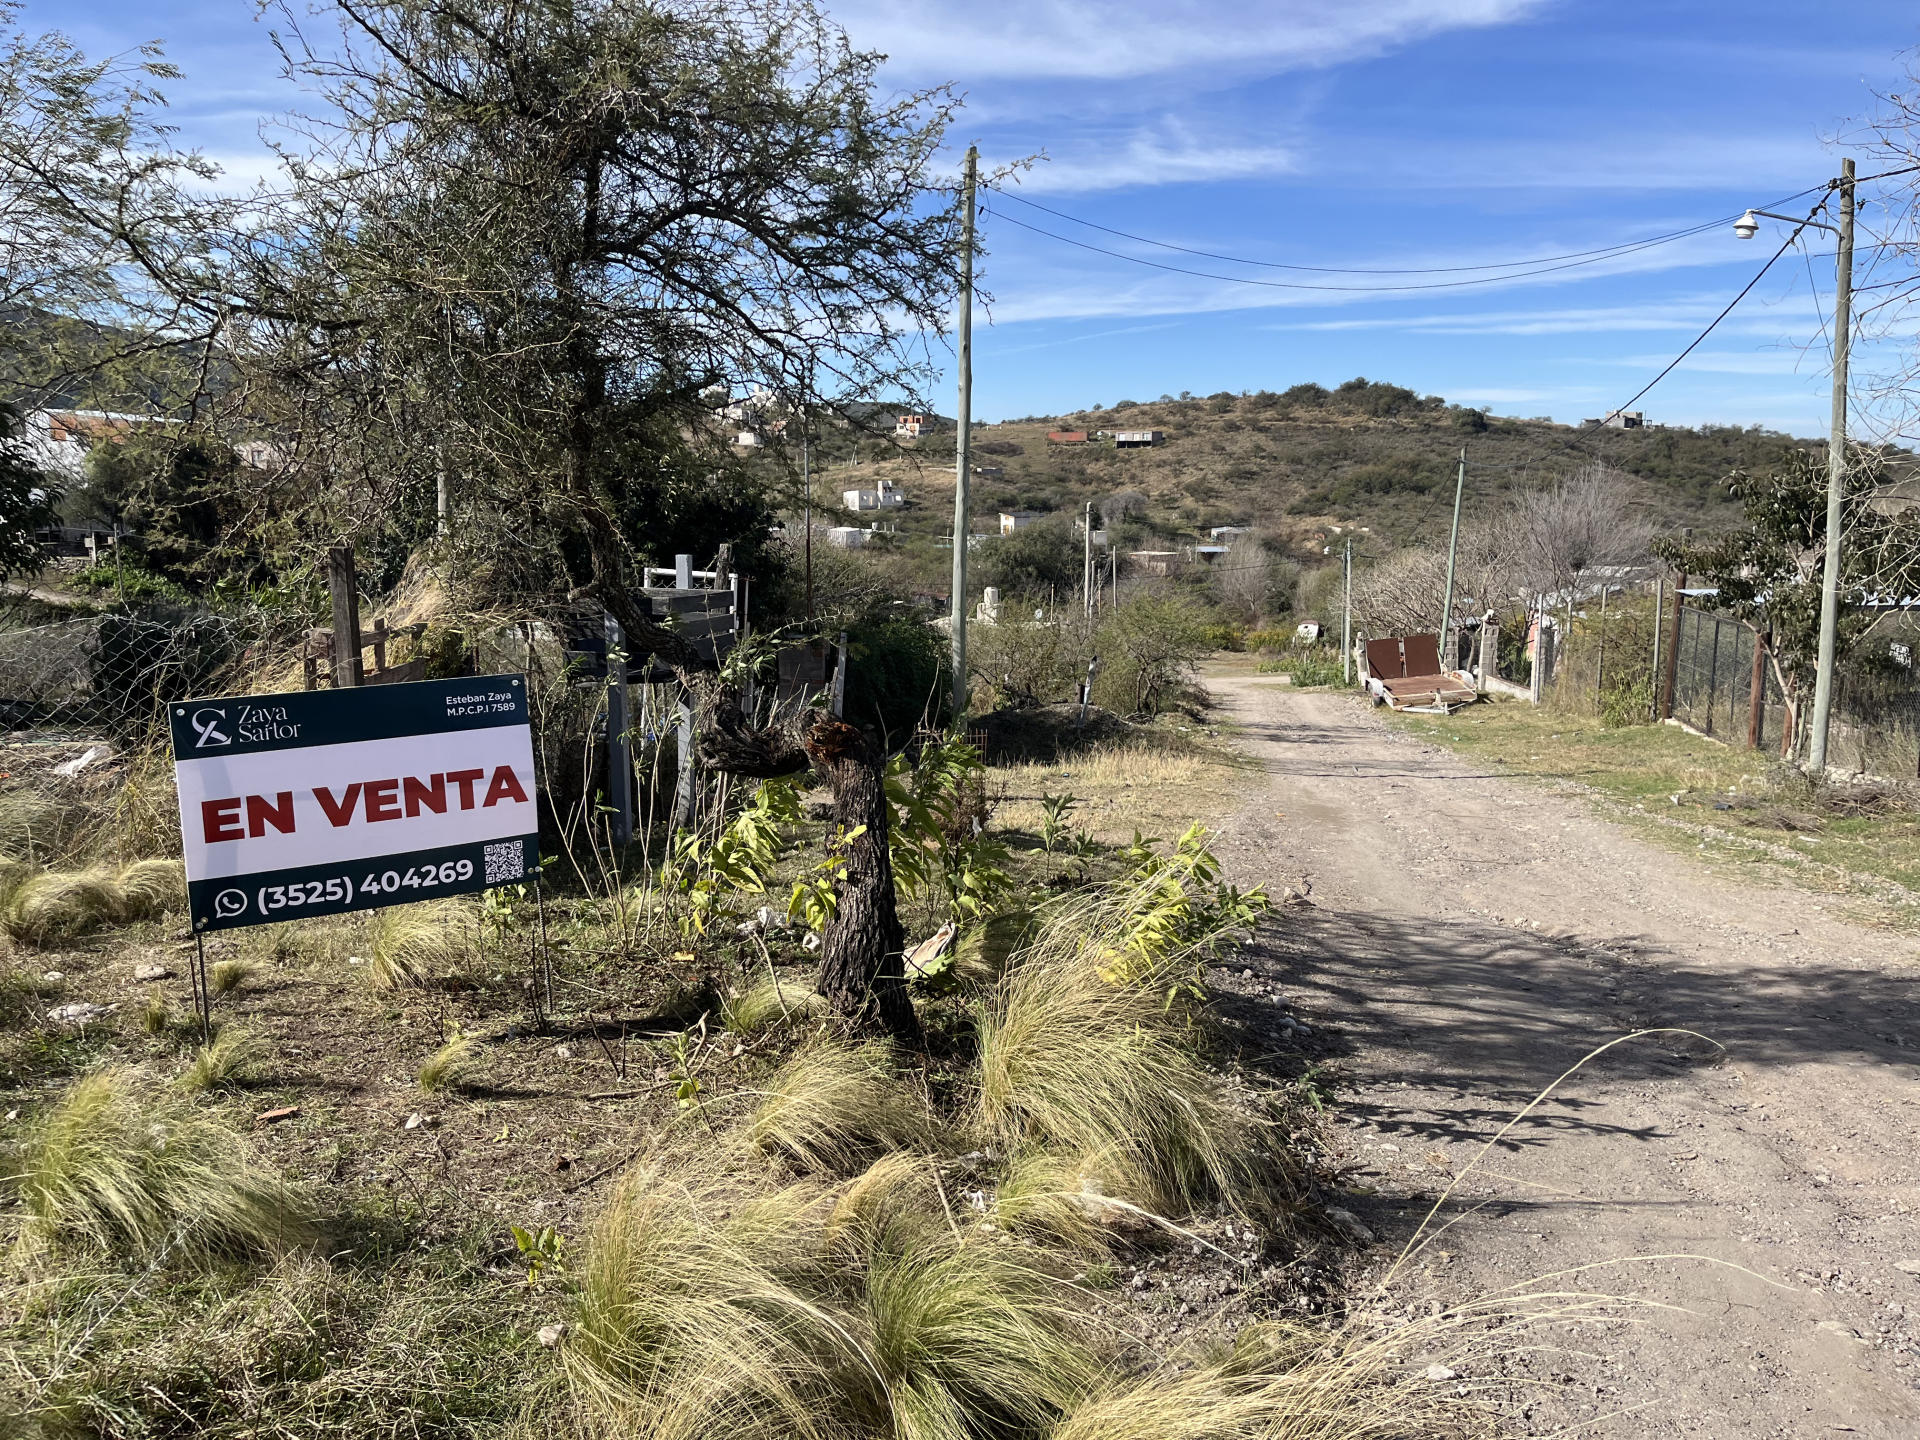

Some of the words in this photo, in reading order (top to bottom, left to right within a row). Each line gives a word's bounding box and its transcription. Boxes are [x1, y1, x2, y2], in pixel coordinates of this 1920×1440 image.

[446, 694, 486, 705] Esteban
[487, 692, 512, 702] Zaya
[237, 705, 288, 725] Zaya
[447, 704, 489, 717] M.P.C.P.I
[491, 702, 516, 713] 7589
[239, 722, 301, 743] Sartor
[201, 790, 296, 844] EN
[311, 765, 529, 828] VENTA
[257, 876, 353, 915] (3525)
[360, 859, 474, 895] 404269
